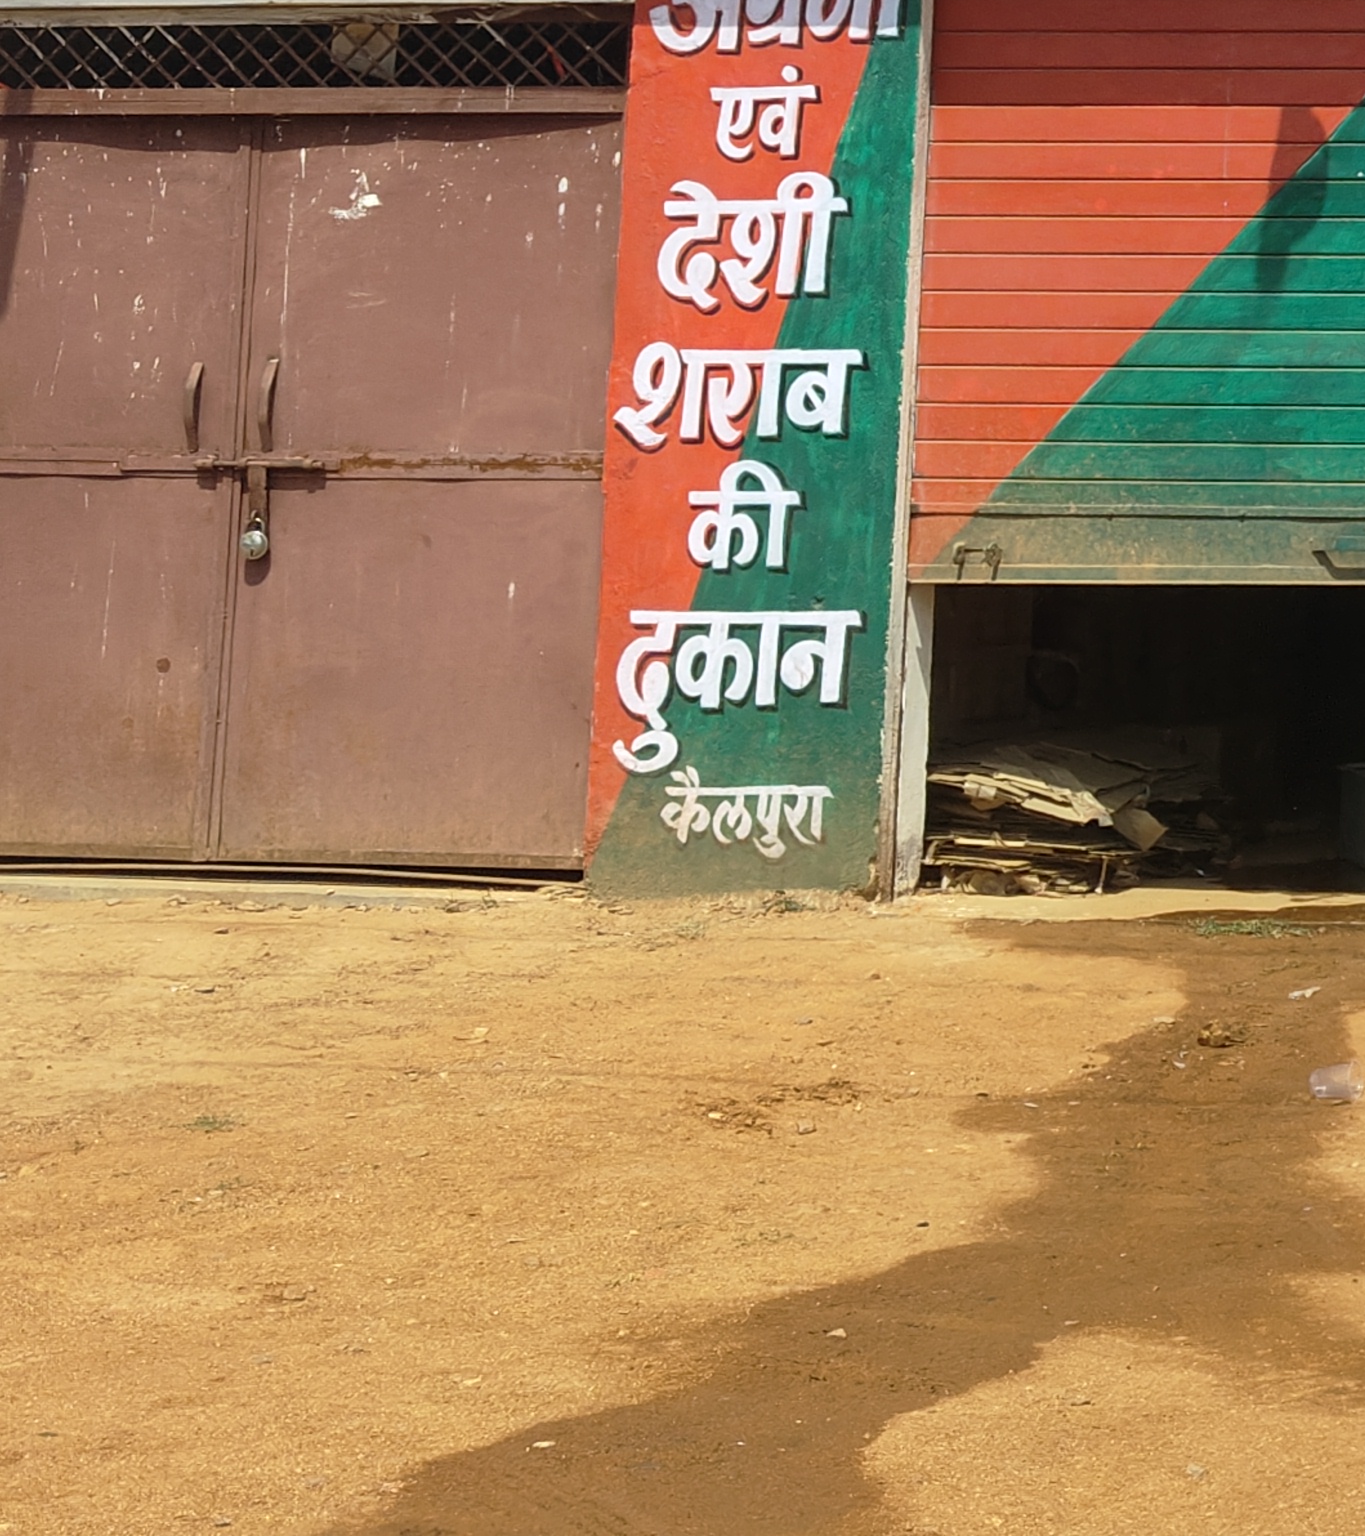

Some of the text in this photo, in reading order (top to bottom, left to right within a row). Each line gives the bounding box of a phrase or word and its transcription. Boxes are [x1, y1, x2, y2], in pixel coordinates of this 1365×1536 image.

[710, 65, 818, 160] एवं
[656, 171, 849, 310] देशी
[613, 341, 864, 447] शराब
[687, 459, 801, 570] की
[612, 609, 862, 774] दुकान
[659, 765, 834, 859] कैलपुरा
